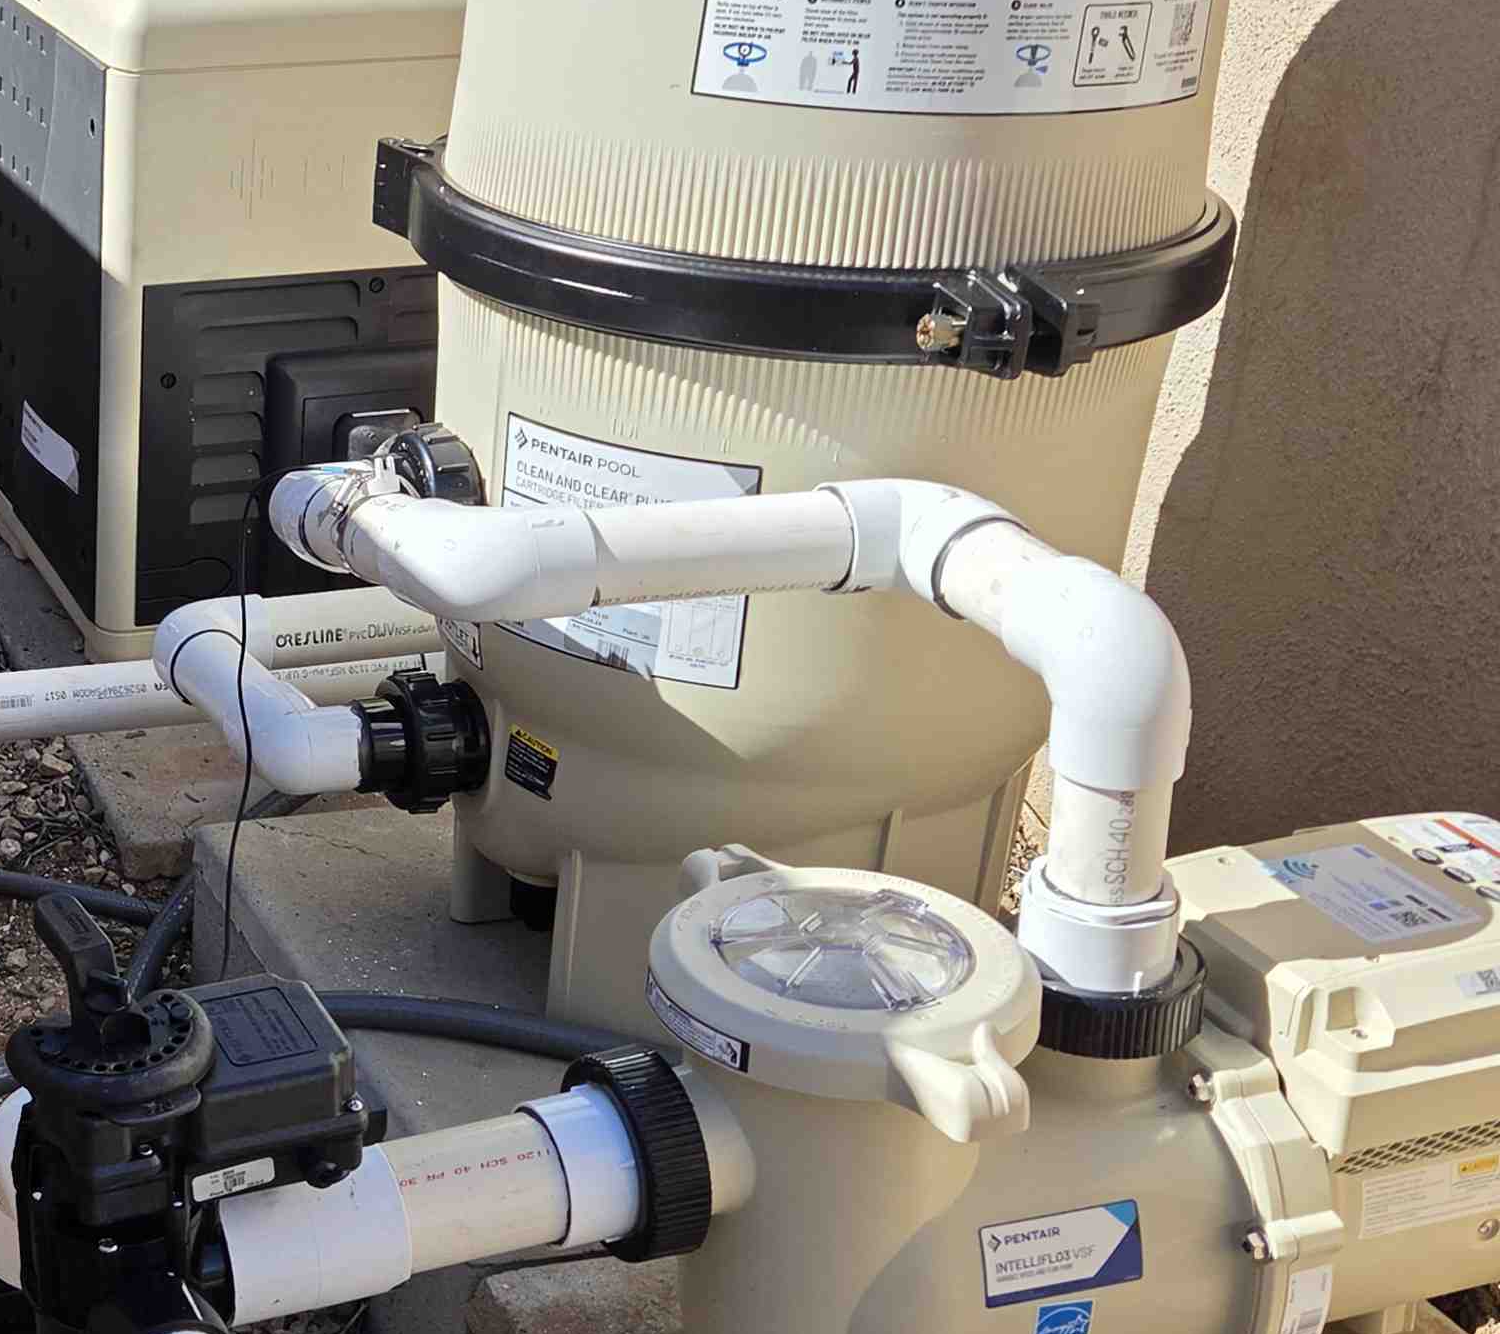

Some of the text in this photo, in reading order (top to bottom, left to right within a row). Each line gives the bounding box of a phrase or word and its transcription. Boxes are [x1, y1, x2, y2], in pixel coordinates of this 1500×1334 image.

[531, 438, 642, 479] PENTAIR POOL
[517, 460, 553, 484] CLEAN
[555, 472, 582, 493] AND
[1109, 818, 1132, 843] 40
[1104, 849, 1130, 884] SCH
[454, 1165, 472, 1176] 40
[1003, 1226, 1061, 1246] PENTAIR
